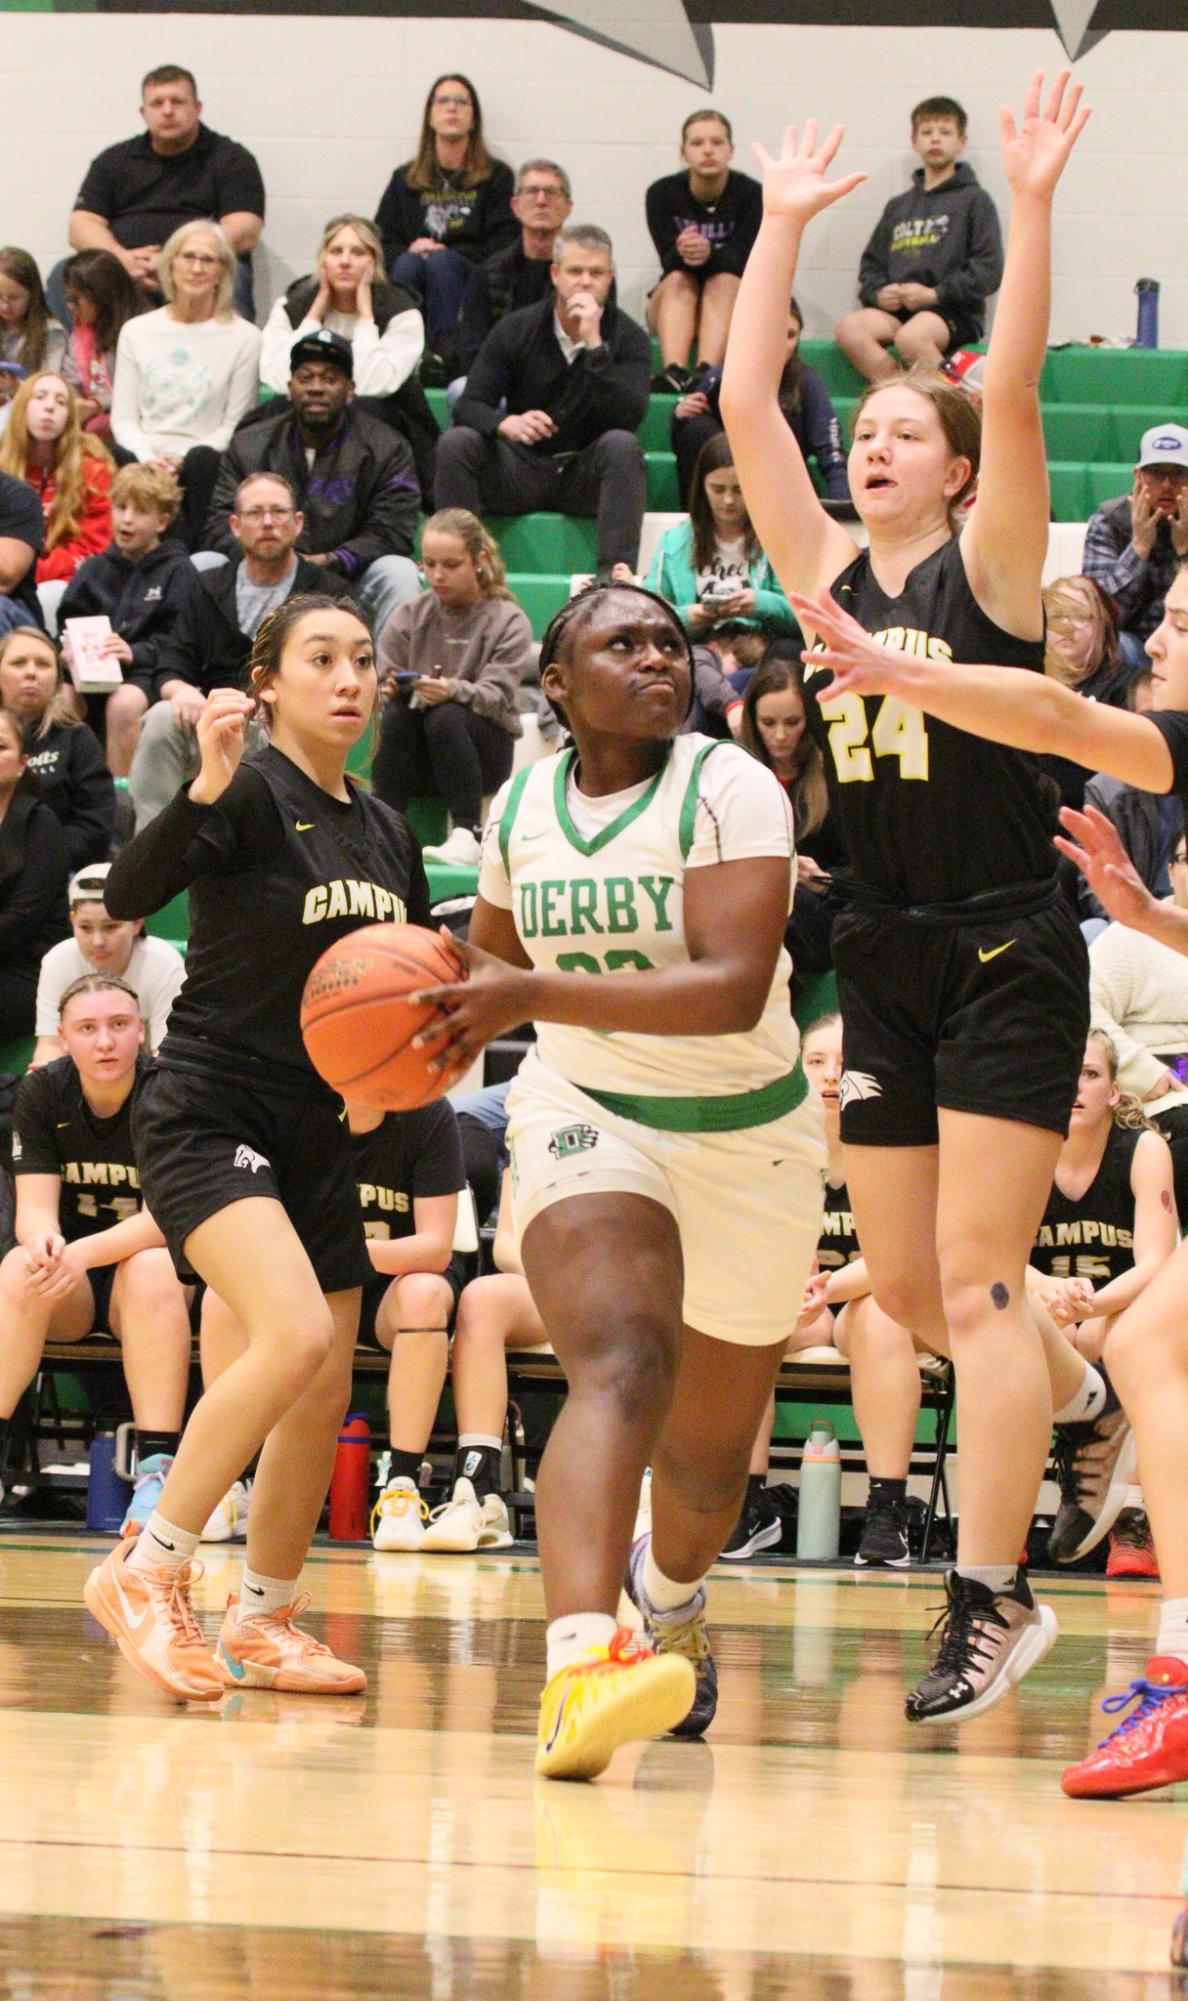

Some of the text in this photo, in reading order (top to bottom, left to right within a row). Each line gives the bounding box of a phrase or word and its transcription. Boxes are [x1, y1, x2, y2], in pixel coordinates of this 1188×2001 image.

[818, 691, 929, 784] 24
[302, 879, 408, 926] CAMPU
[520, 876, 675, 938] DERBY
[61, 1162, 141, 1189] AMPU
[357, 1183, 410, 1213] PUS
[1034, 1220, 1134, 1249] AMPUS
